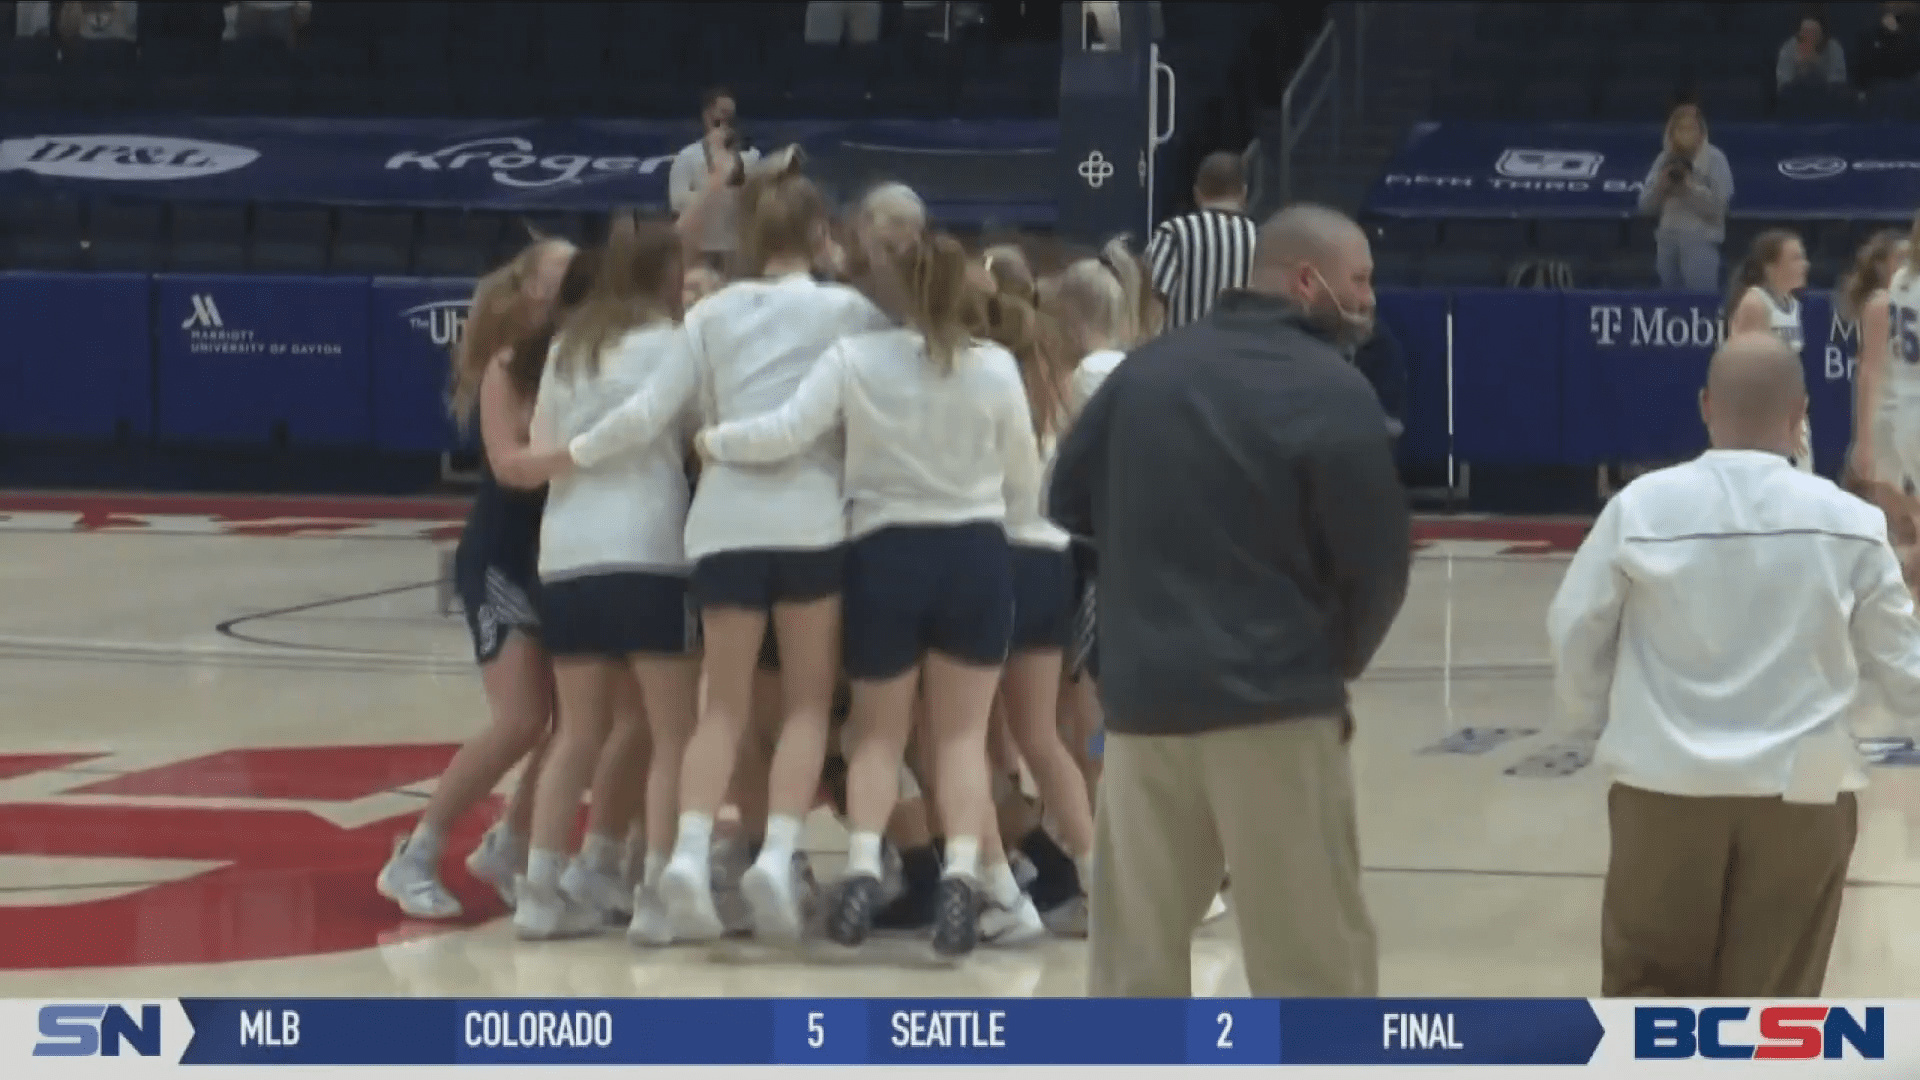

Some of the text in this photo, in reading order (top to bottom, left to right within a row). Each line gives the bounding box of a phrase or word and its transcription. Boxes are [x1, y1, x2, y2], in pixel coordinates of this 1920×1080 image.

[1590, 306, 1622, 345] T
[190, 342, 266, 354] UNIVERSITY
[291, 343, 342, 355] DAYTON
